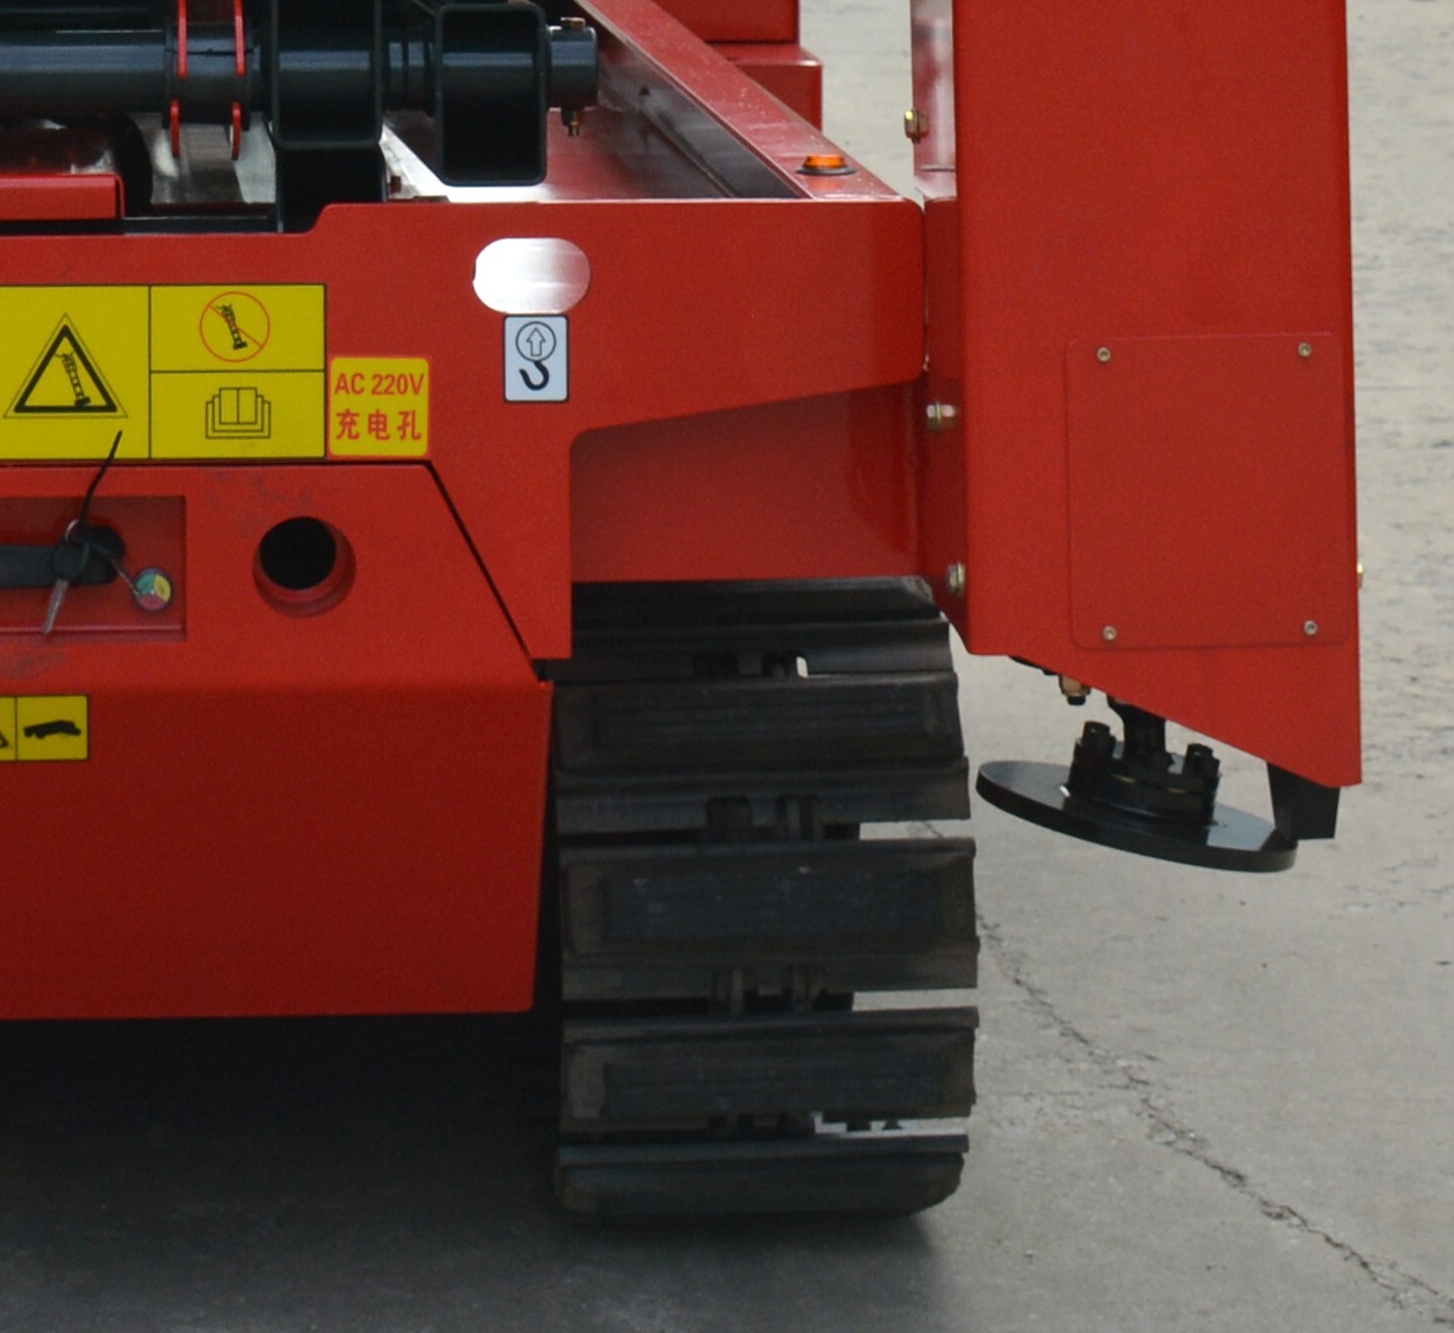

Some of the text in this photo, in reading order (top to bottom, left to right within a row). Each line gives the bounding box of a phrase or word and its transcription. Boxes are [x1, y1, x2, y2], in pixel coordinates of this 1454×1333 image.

[334, 372, 425, 396] AC 220V
[335, 407, 422, 441] 充电孔
